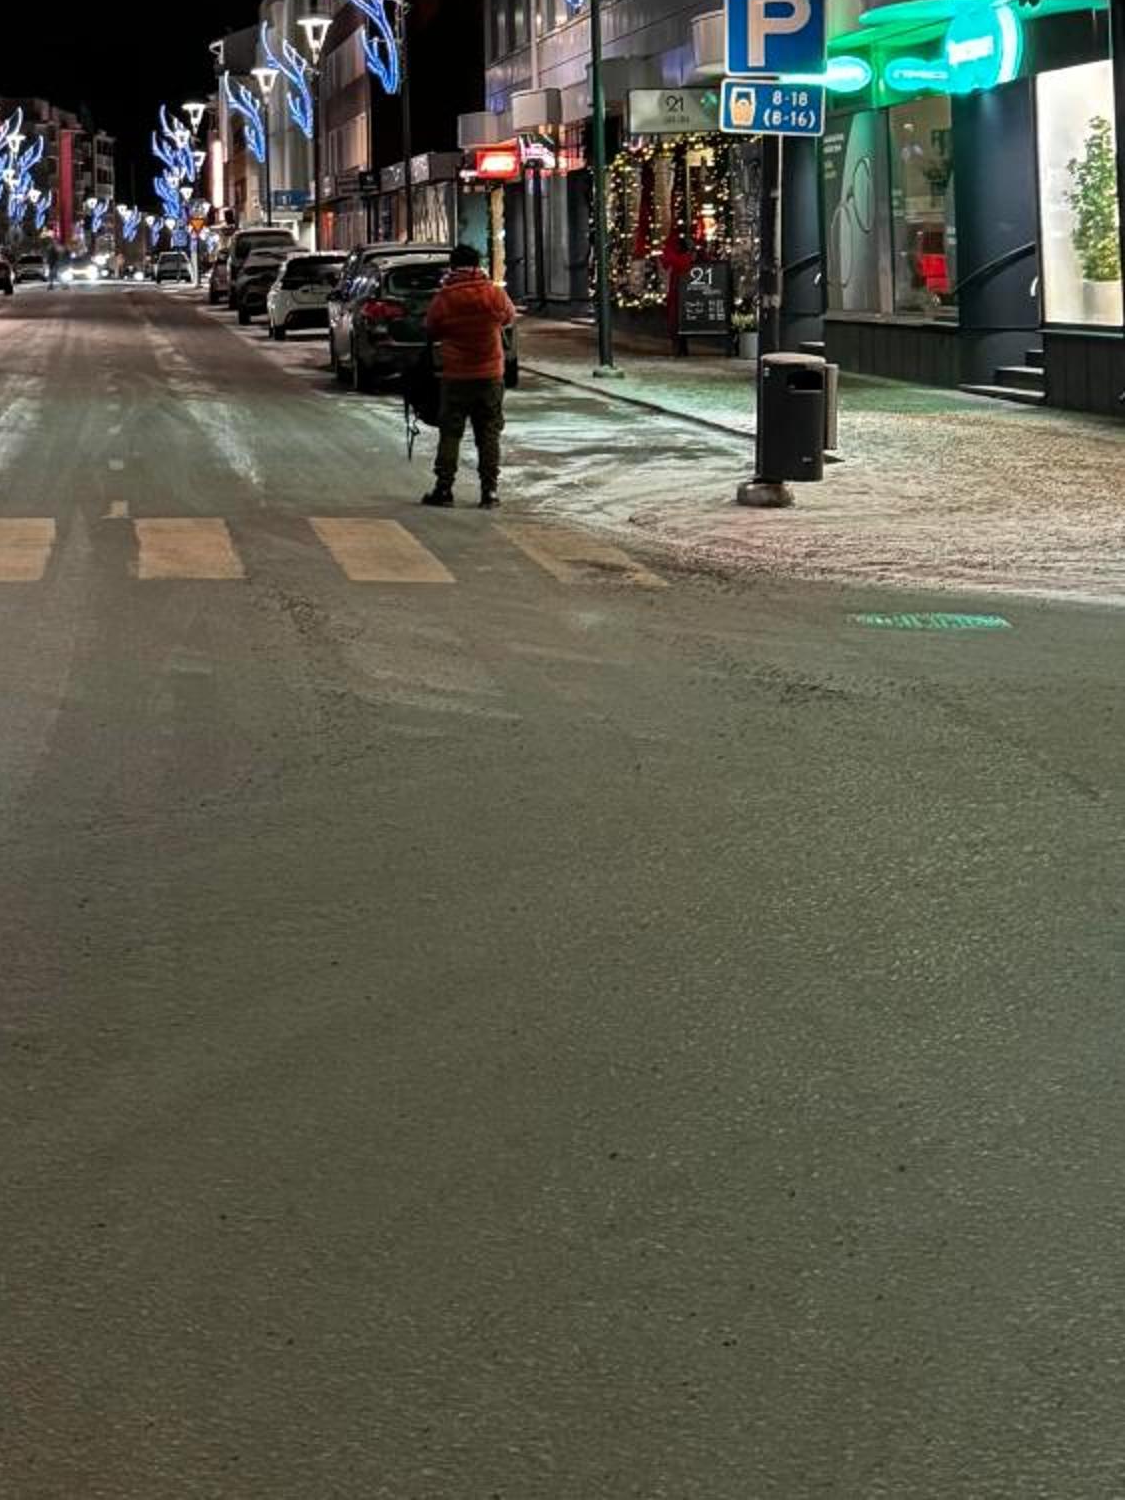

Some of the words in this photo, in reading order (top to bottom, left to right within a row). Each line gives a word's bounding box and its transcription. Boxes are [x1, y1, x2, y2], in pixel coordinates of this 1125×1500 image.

[666, 95, 684, 112] 21
[772, 90, 809, 107] 8-18
[762, 107, 816, 128] (8-16)
[690, 267, 713, 285] 21
